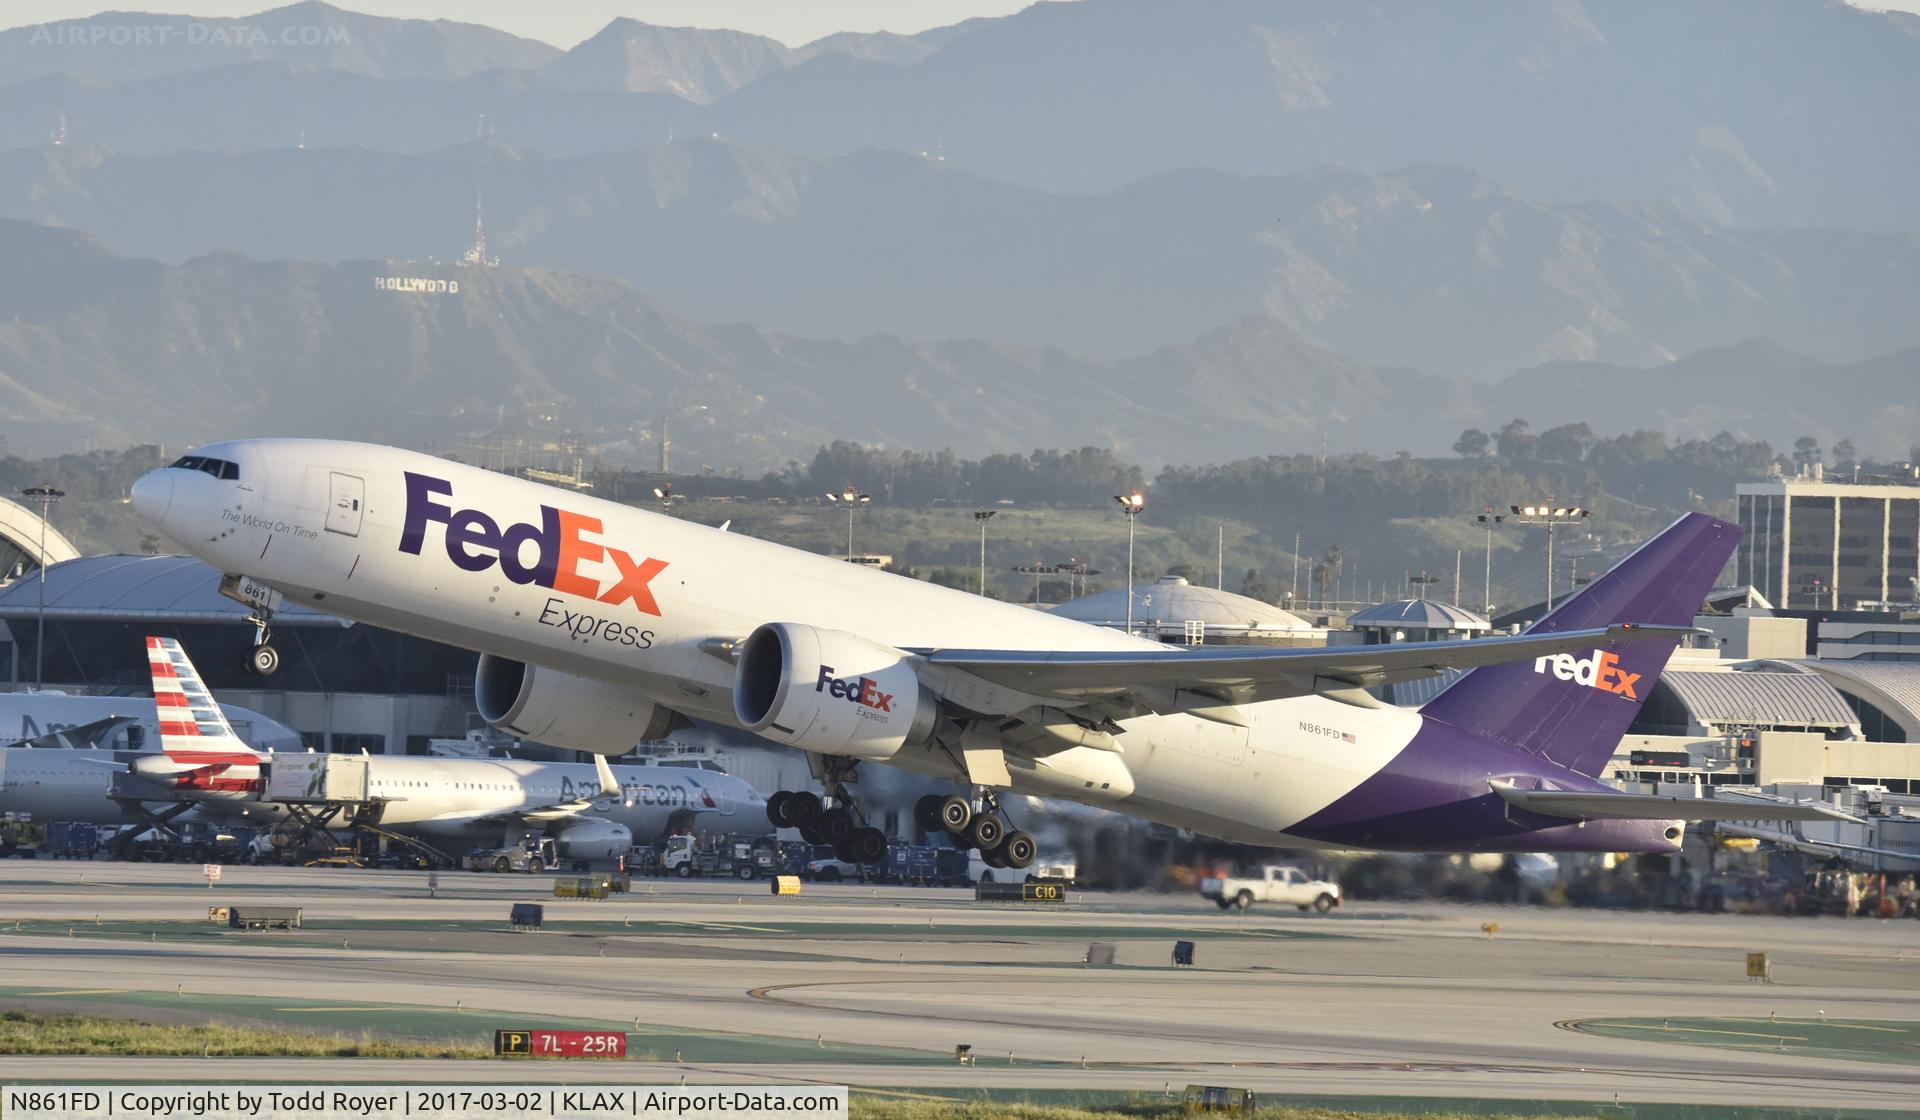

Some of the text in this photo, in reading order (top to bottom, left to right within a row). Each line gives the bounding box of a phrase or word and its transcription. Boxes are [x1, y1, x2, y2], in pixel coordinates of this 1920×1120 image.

[375, 277, 459, 293] HOLLYWOOD
[222, 509, 318, 540] The World On Time
[398, 471, 670, 617] FedEx
[244, 584, 265, 601] 861
[538, 597, 655, 649] Express
[816, 664, 893, 713] FedEx
[856, 706, 889, 725] Express
[1299, 721, 1340, 739] N861FD
[1035, 886, 1057, 899] C10
[510, 1034, 522, 1051] P
[541, 1035, 562, 1052] 7L
[582, 1036, 618, 1052] 25R
